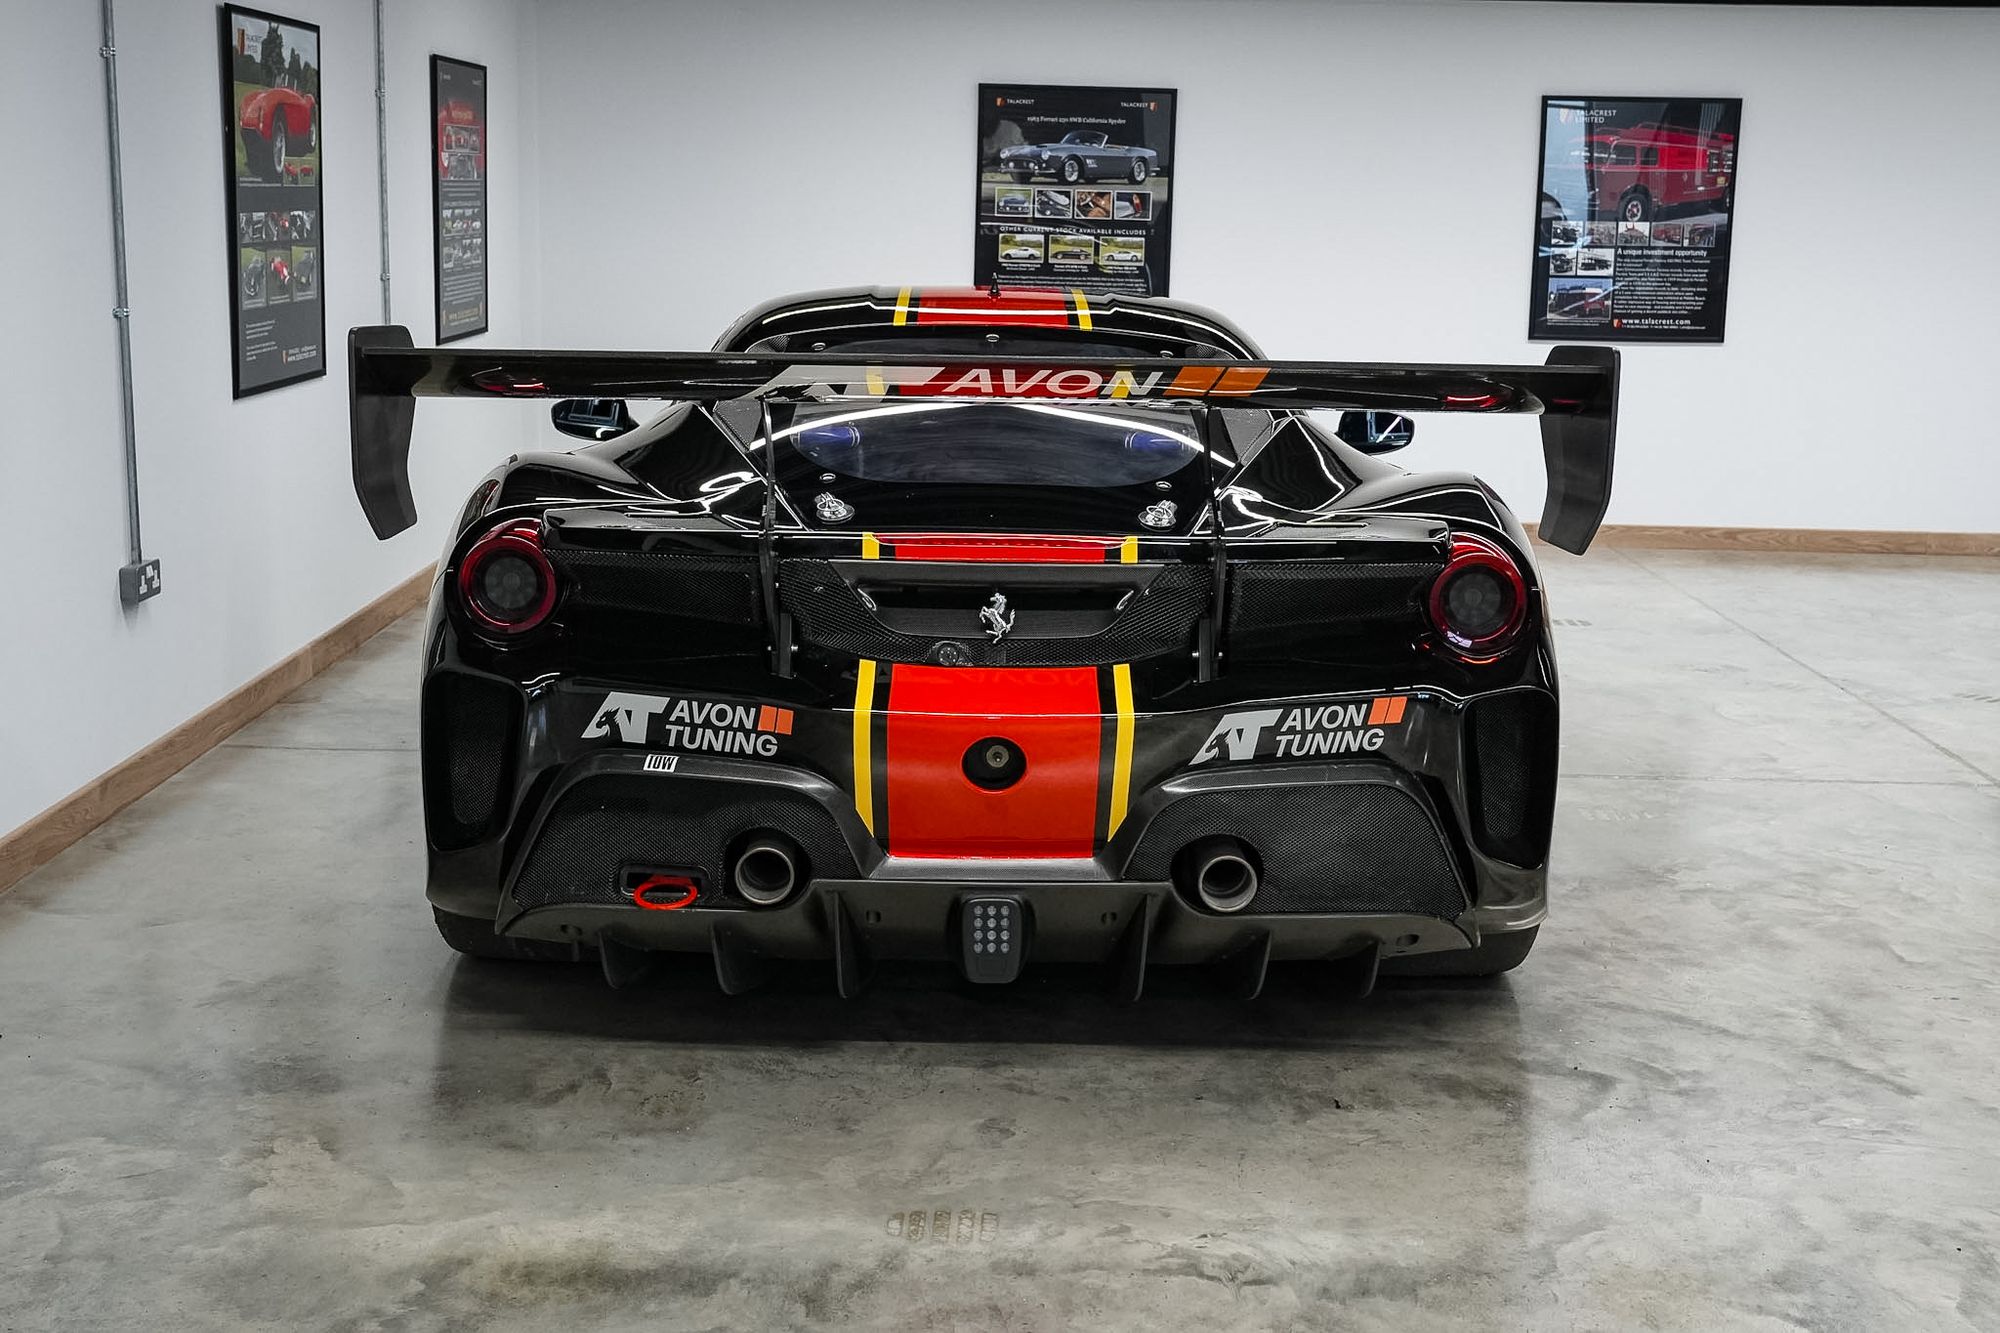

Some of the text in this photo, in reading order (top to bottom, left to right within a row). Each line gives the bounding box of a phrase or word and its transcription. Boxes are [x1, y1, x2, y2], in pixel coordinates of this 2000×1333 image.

[1675, 249, 1707, 257] opportunity
[941, 366, 1164, 396] AVON
[668, 699, 756, 730] AVON
[1280, 703, 1368, 732] AVON
[665, 724, 778, 757] TUNING
[1275, 728, 1385, 758] TUNING
[646, 755, 675, 770] TOW
